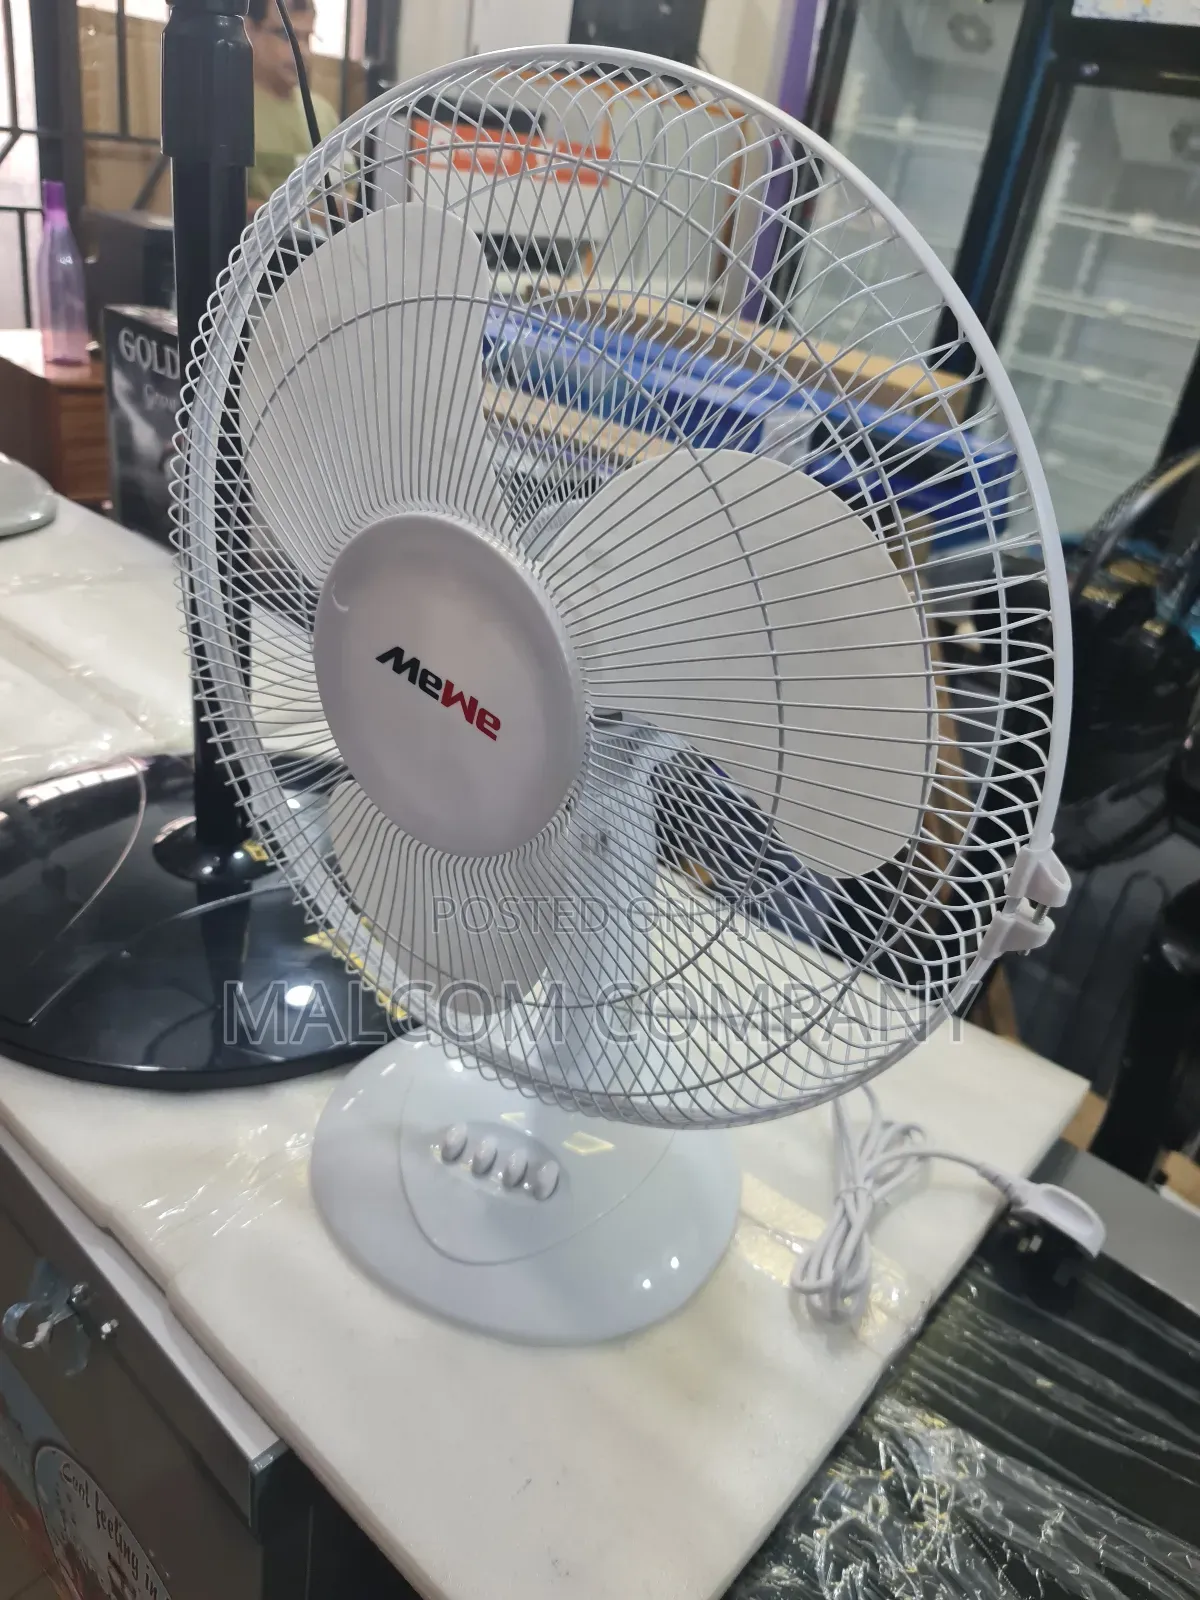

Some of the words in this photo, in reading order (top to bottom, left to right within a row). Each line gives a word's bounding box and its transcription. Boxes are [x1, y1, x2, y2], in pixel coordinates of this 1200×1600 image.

[119, 327, 180, 380] GOLD
[375, 646, 501, 741] MeWe
[95, 1490, 139, 1581] feeling
